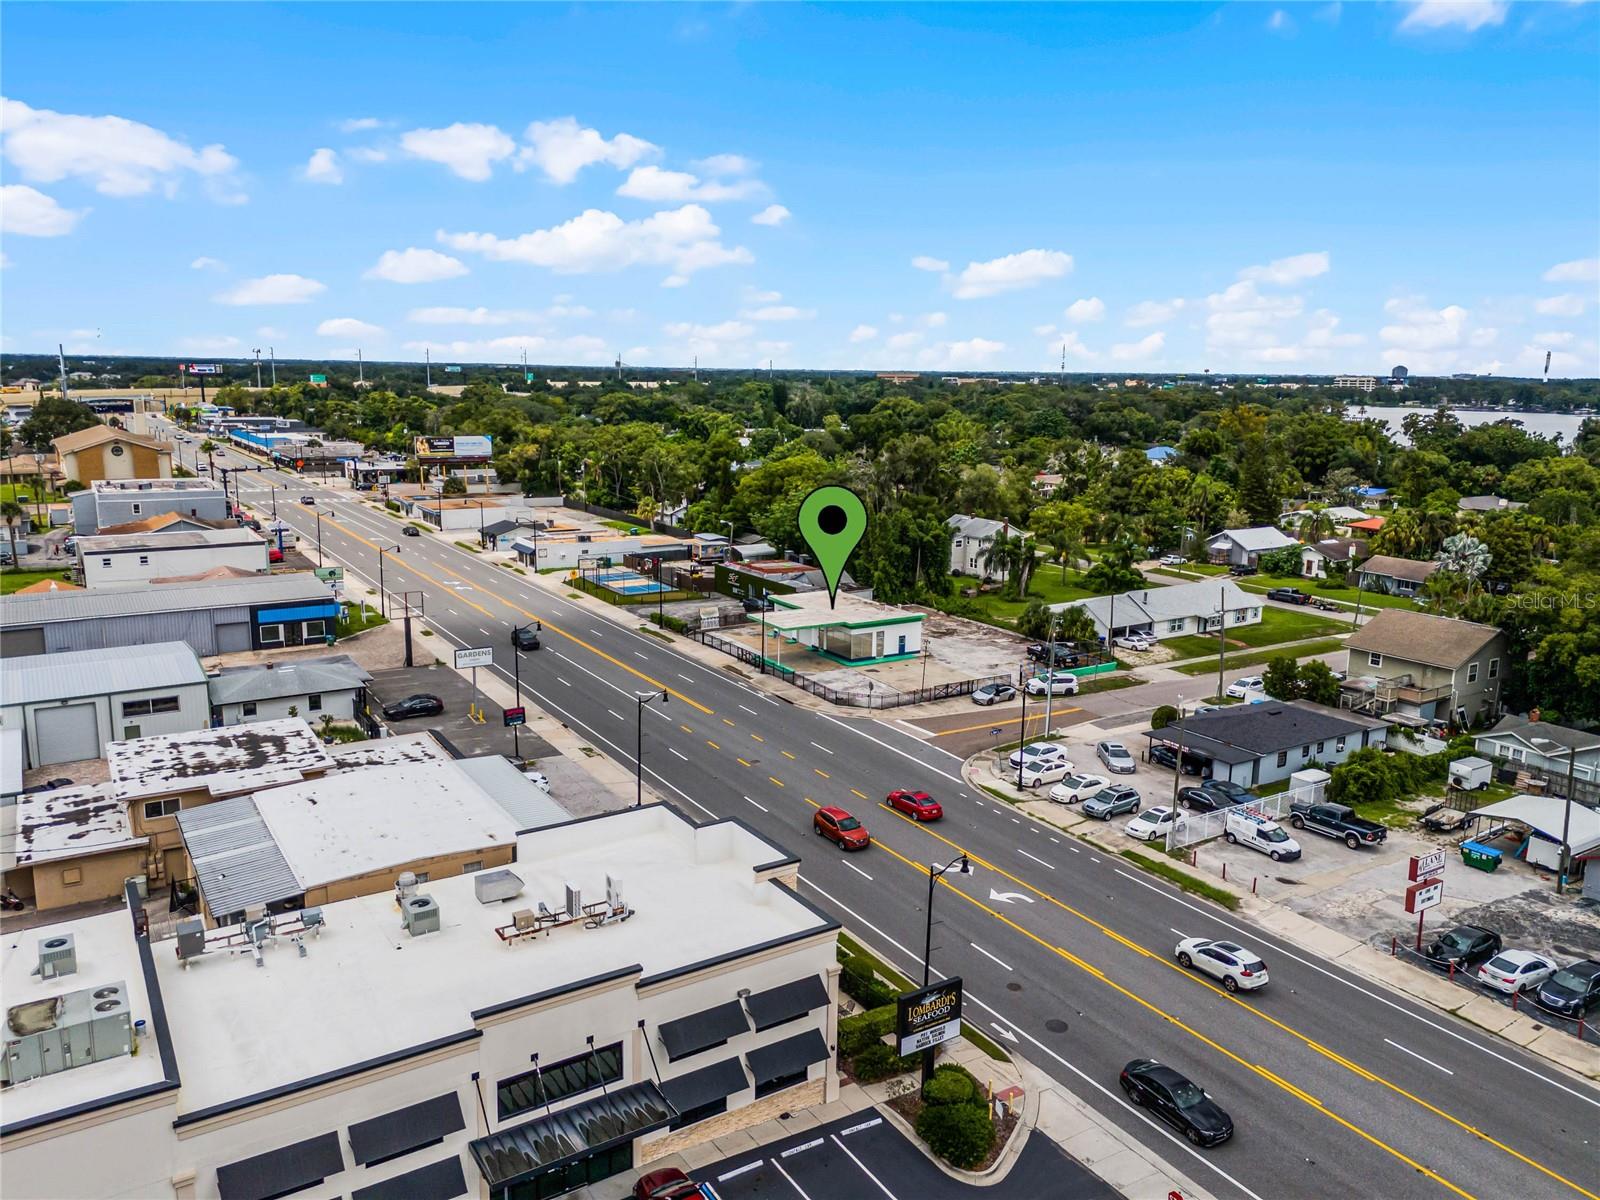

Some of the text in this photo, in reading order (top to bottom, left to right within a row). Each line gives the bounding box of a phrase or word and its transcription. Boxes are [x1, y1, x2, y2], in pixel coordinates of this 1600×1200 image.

[457, 649, 491, 660] GARDENS
[908, 991, 957, 1022] LOMBARDI'S
[913, 1005, 951, 1025] SEAFOOD
